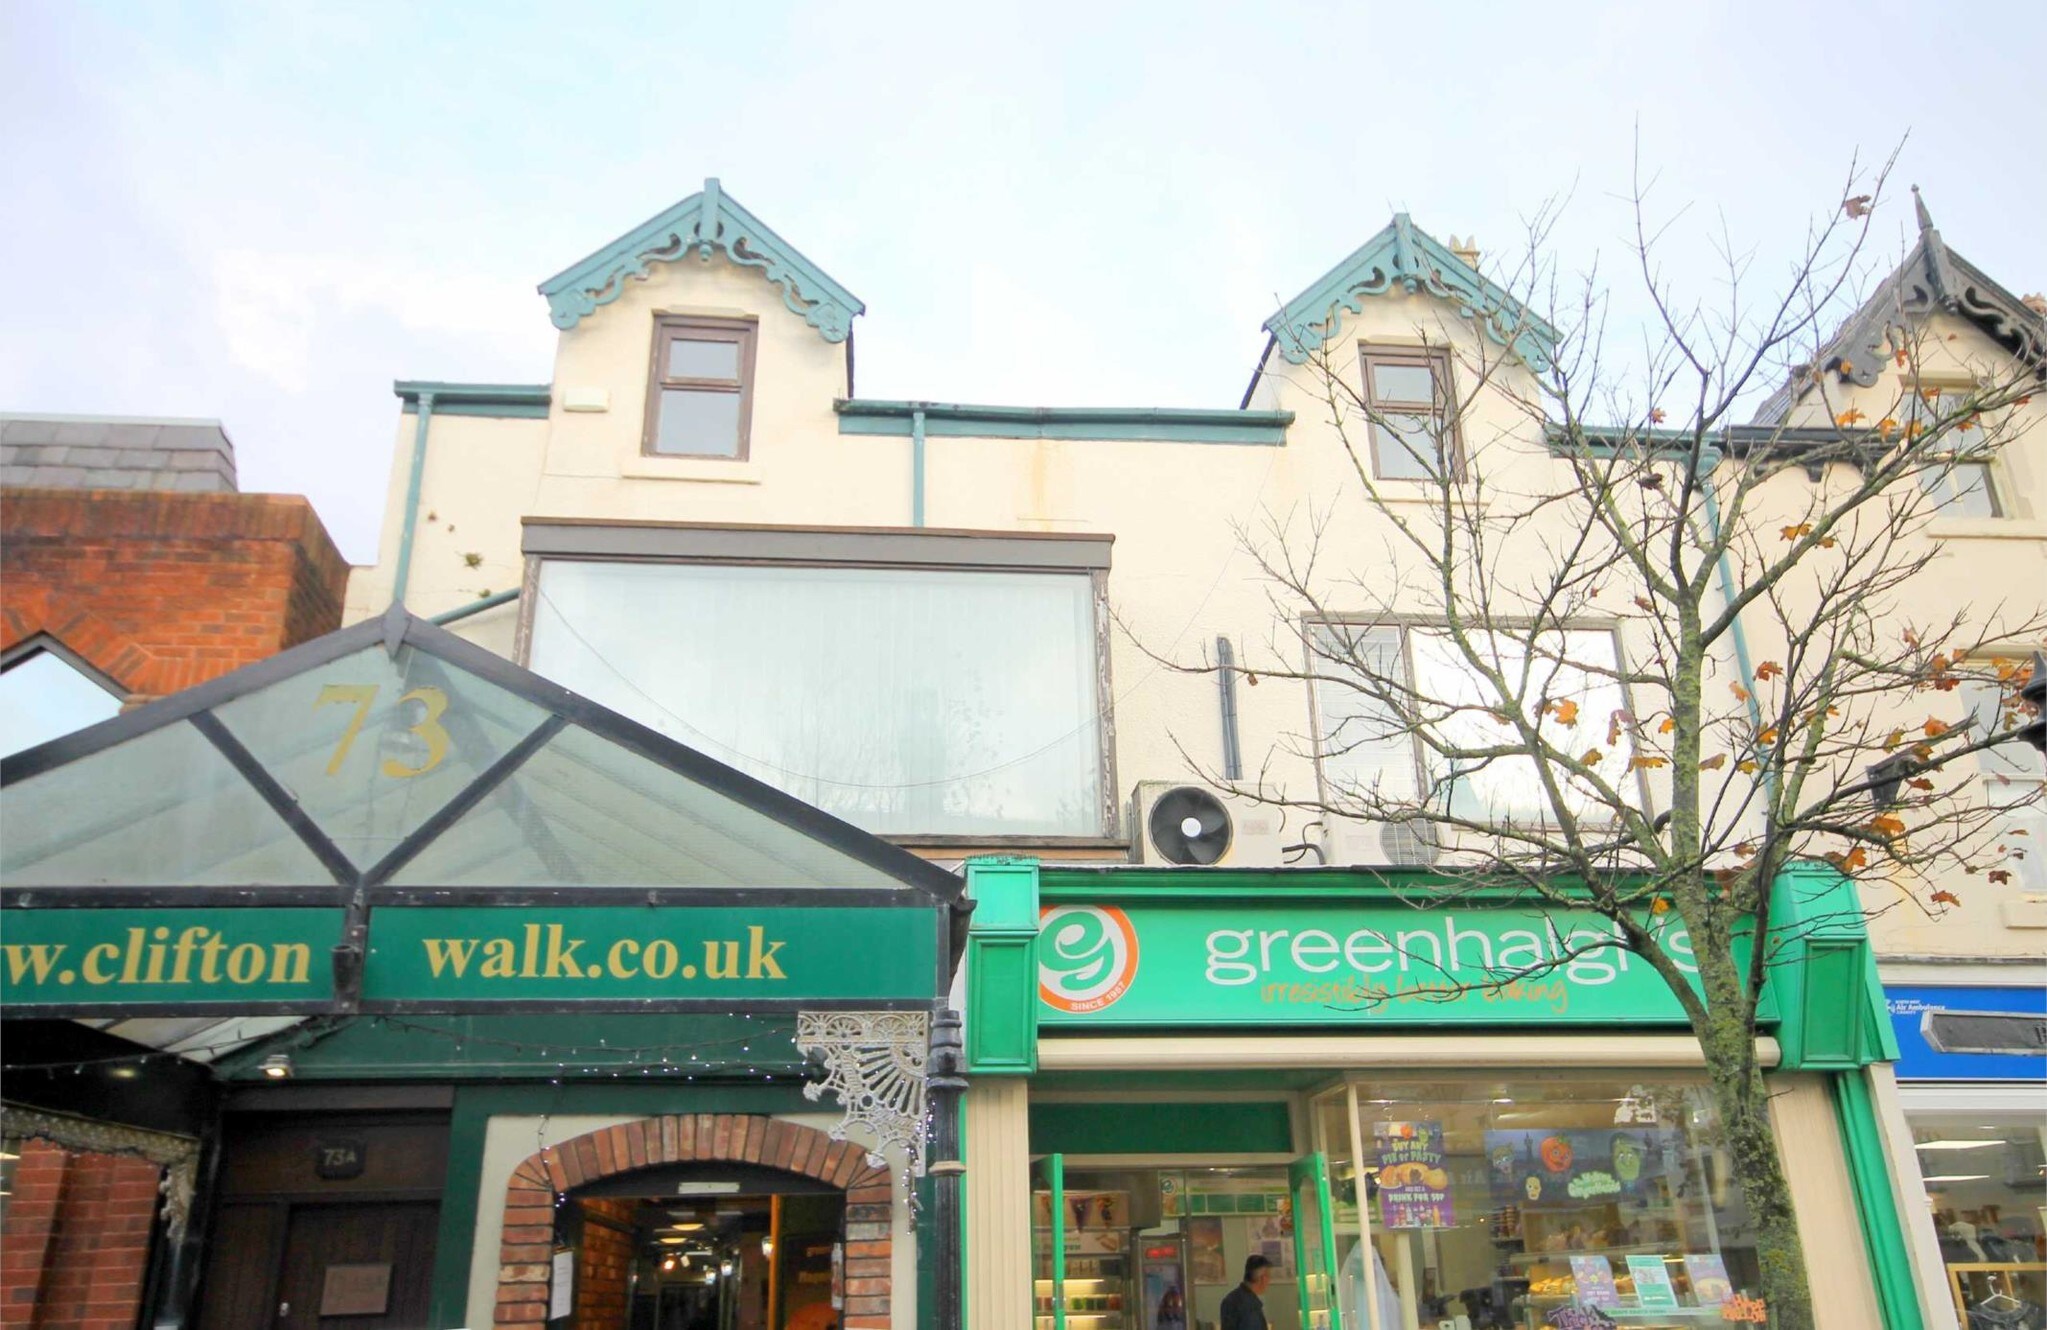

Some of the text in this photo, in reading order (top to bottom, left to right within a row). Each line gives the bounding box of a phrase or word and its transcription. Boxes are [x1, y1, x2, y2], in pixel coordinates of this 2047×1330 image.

[311, 683, 450, 779] 73
[1, 926, 311, 985] w.clifton
[422, 923, 788, 980] walk.co.uk
[1070, 997, 1105, 1011] SINCE
[1392, 1141, 1428, 1152] BUY ANY
[324, 1149, 357, 1165] 73A
[1410, 1151, 1441, 1164] PASTY
[1388, 1194, 1413, 1203] DRINK
[1413, 1193, 1429, 1202] FOR
